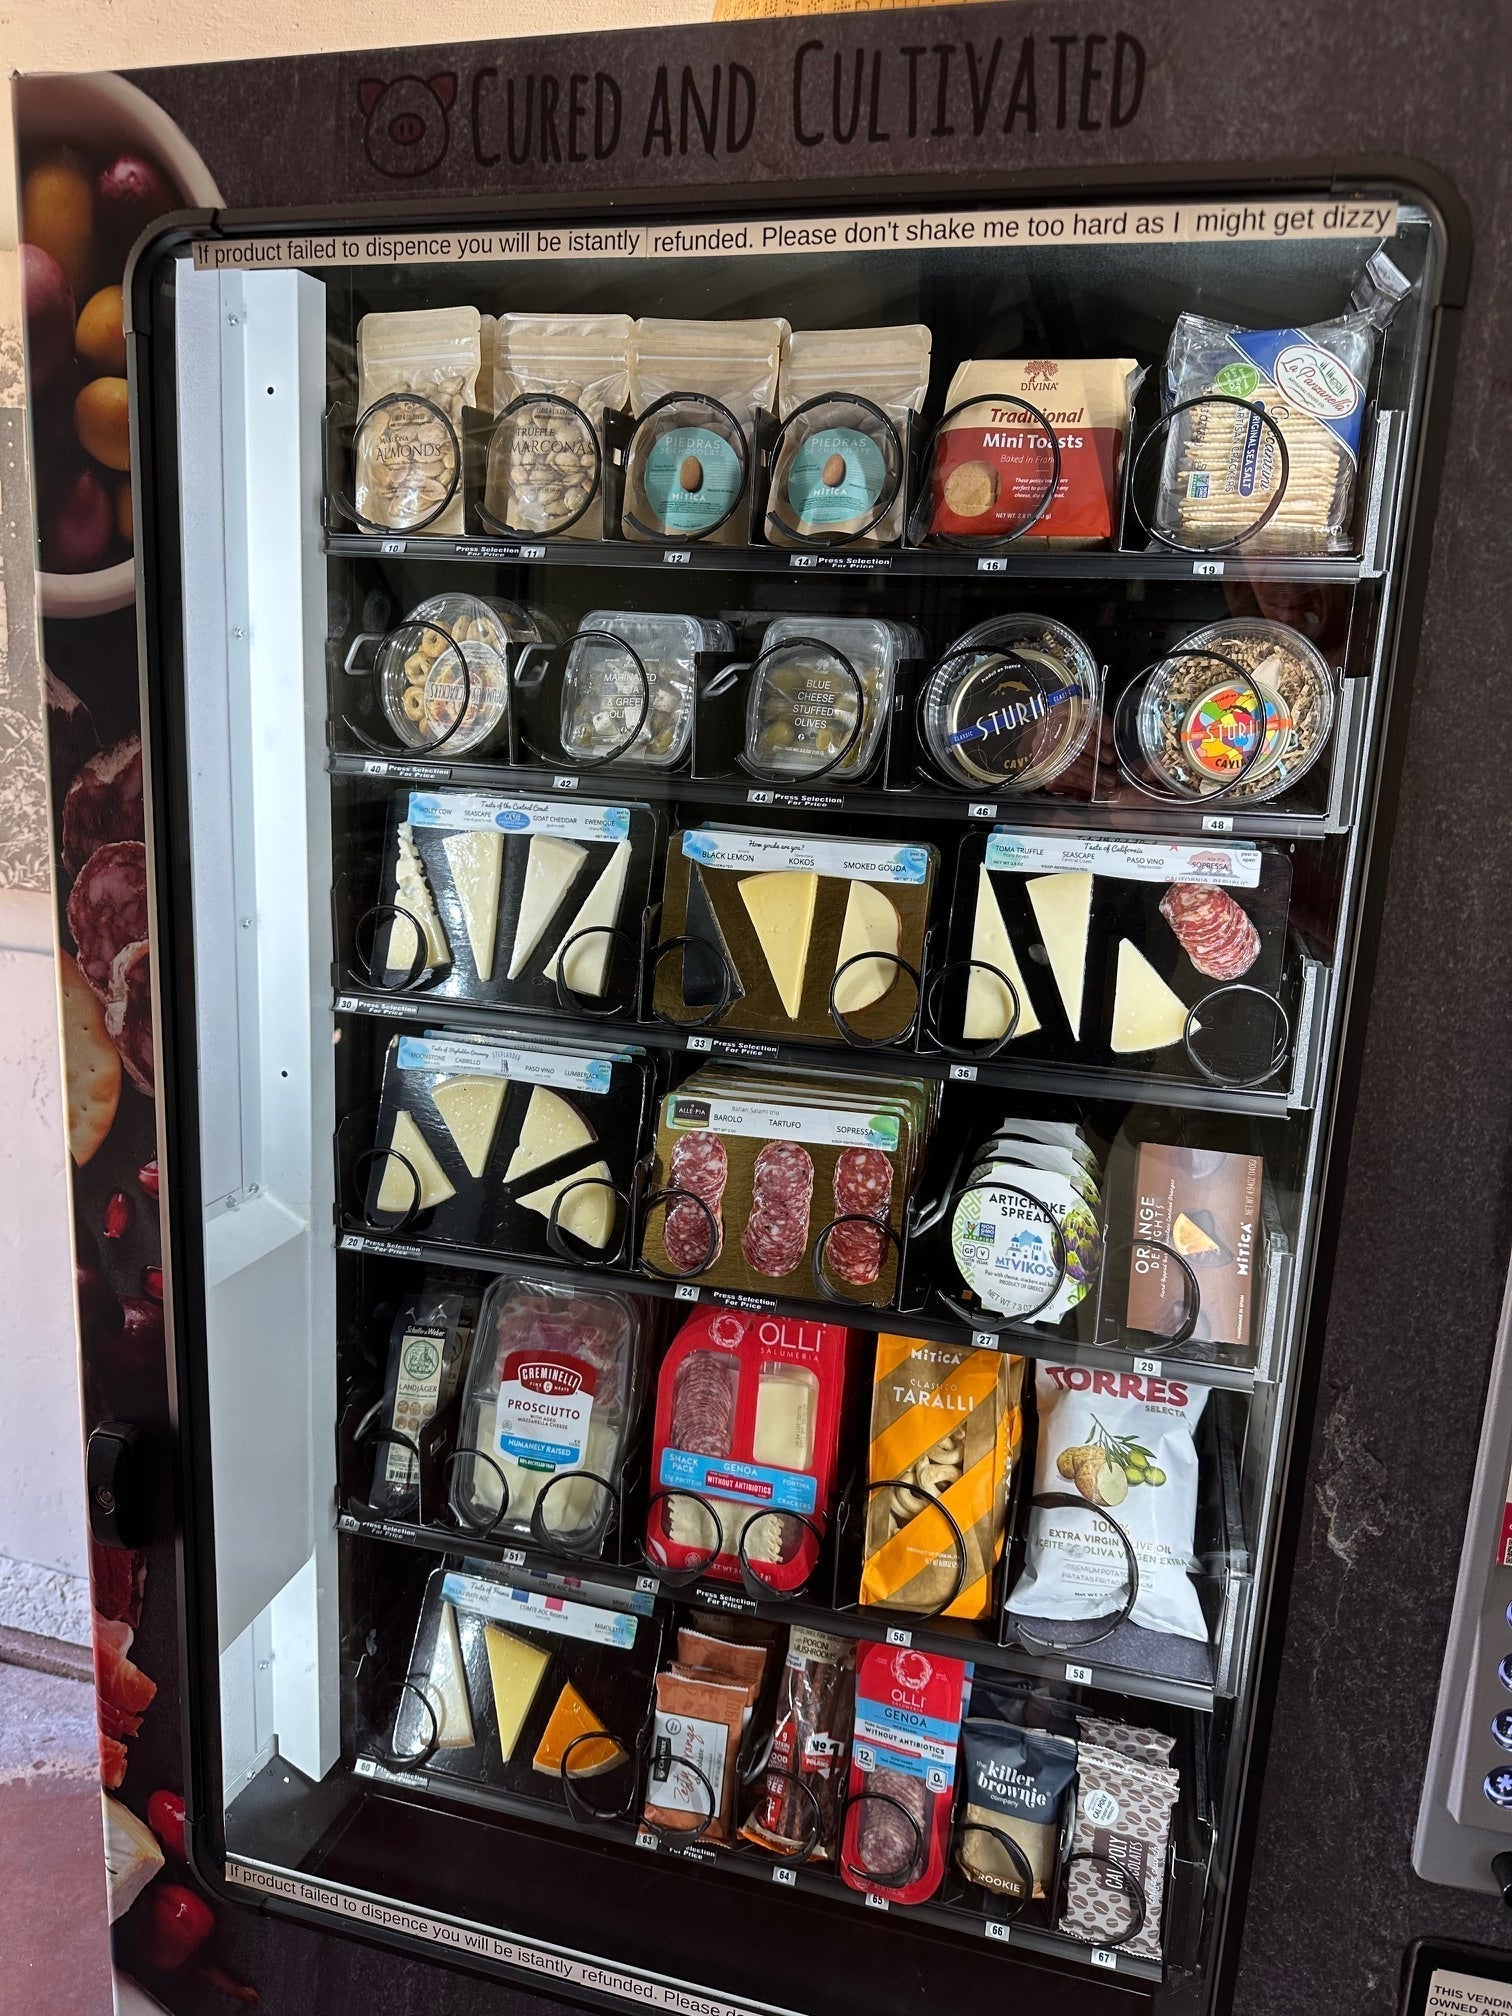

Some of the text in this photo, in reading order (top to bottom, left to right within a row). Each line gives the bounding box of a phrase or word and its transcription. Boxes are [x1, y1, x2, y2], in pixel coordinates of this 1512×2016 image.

[472, 32, 1147, 168] CURED AND CULTIVATED
[214, 240, 283, 267] product
[286, 237, 337, 261] failed
[341, 238, 360, 259] to
[365, 235, 452, 262] dispence
[457, 237, 493, 261] you
[498, 232, 531, 255] will
[536, 231, 562, 253] be
[567, 228, 641, 257] istantly
[652, 226, 754, 252] refunded.
[762, 221, 838, 249] Please
[844, 219, 900, 245] don't
[905, 216, 976, 242] shake
[982, 217, 1021, 239] me
[1027, 214, 1065, 238] too
[1072, 211, 1127, 237] hard
[1134, 215, 1165, 236] as
[1174, 211, 1180, 234] I
[1196, 205, 1266, 237] might
[1273, 207, 1314, 237] get
[1322, 203, 1392, 236] dizzy
[1020, 382, 1058, 391] DIVINA
[665, 437, 721, 449] PIEDRAS
[811, 437, 867, 448] PIEDRAS
[983, 433, 1084, 448] Mini Toasts
[376, 443, 442, 463] ALMONDS
[1000, 455, 1024, 464] Baked
[1225, 447, 1240, 492] CRACKERS
[1242, 451, 1256, 489] SEA SALT
[670, 554, 683, 563] 12
[797, 557, 811, 567] 14
[986, 562, 999, 570] 16
[1202, 565, 1215, 574] 19
[806, 679, 832, 689] BLUE
[797, 691, 835, 704] CHEESE
[792, 704, 834, 717] STUFFED
[794, 718, 828, 729] OLIVES
[370, 765, 381, 774] 40
[560, 780, 571, 789] 42
[754, 792, 766, 802] 44
[774, 793, 842, 804] Press Selection
[976, 807, 989, 816] 46
[550, 816, 578, 824] CHEDDAR
[1211, 821, 1225, 830] 48
[996, 845, 1044, 855] TOMA TRUFFLE
[1111, 844, 1144, 854] California
[702, 850, 755, 862] BLACK LEMON
[1062, 851, 1095, 859] SEASCAPE
[788, 858, 815, 867] KOKOS
[843, 861, 907, 872] SMOKED GOUDA
[1146, 858, 1165, 866] VINO
[1192, 861, 1228, 871] SOPRESSA
[694, 1039, 706, 1048] 33
[738, 1043, 777, 1052] Selection
[455, 1057, 481, 1065] CABRILLO
[564, 1070, 600, 1080] LUMBERJACK
[957, 1068, 969, 1077] 36
[713, 1114, 743, 1123] BAROLO
[768, 1119, 802, 1129] TARTUFO
[836, 1126, 874, 1136] SOPRESSA
[1245, 1203, 1253, 1216] NET
[1001, 1207, 1051, 1224] SPREAD
[347, 1238, 359, 1246] 20
[965, 1247, 973, 1255] GF
[681, 1288, 693, 1297] 24
[987, 1289, 1011, 1307] NET WT
[714, 1291, 776, 1306] Press Selection
[758, 1322, 821, 1352] OLLI
[980, 1335, 992, 1345] 27
[760, 1347, 819, 1362] SALUMERIA
[1141, 1363, 1154, 1372] 29
[522, 1367, 578, 1388] CREMINELLI
[910, 1379, 957, 1391] CLASSICO
[1045, 1366, 1189, 1407] TORRES
[893, 1386, 974, 1412] TARALLI
[507, 1399, 581, 1420] PROSCIUTTO
[1145, 1405, 1187, 1418] SELECTA
[508, 1439, 571, 1456] HUMANELY RAISED
[669, 1453, 699, 1466] SNACK
[672, 1463, 695, 1474] PACK
[723, 1462, 758, 1476] GENOA
[707, 1475, 772, 1494] WITHOUT ANTIBIOTICS
[782, 1478, 810, 1489] FONTINA
[777, 1497, 811, 1510] CRACKERS
[344, 1519, 355, 1527] 50
[1049, 1528, 1171, 1554] EXTRA VIRGIN OIL
[510, 1551, 519, 1561] 51
[1083, 1546, 1115, 1558] OLIVA
[642, 1580, 653, 1589] 54
[696, 1589, 756, 1607] Press Selection
[722, 1599, 743, 1610] Price
[519, 1604, 568, 1621] COMTE Reserve
[594, 1622, 624, 1635] MIMOLETTE
[893, 1632, 905, 1642] 56
[802, 1637, 829, 1650] PORCINI
[794, 1643, 837, 1660] MUSHROOMS
[1073, 1669, 1085, 1679] 58
[891, 1689, 924, 1708] OLLI
[884, 1708, 928, 1729] GENOA
[864, 1727, 945, 1755] WITHOUT ANTIBIOTICS
[361, 1763, 371, 1771] 60
[976, 1760, 1035, 1787] the killer
[977, 1771, 1047, 1808] brownie
[990, 1794, 1019, 1808] company
[1097, 1794, 1108, 1809] POLY
[642, 1835, 652, 1844] 63
[779, 1871, 789, 1880] 64
[992, 1925, 1003, 1936] 66
[229, 1864, 721, 2016] If product failed to dispence you will be istantly refunded. Please
[1098, 1952, 1109, 1963] 67
[1434, 1985, 1512, 2010] THIS VENDIN
[1429, 1997, 1478, 2014] OWNED
